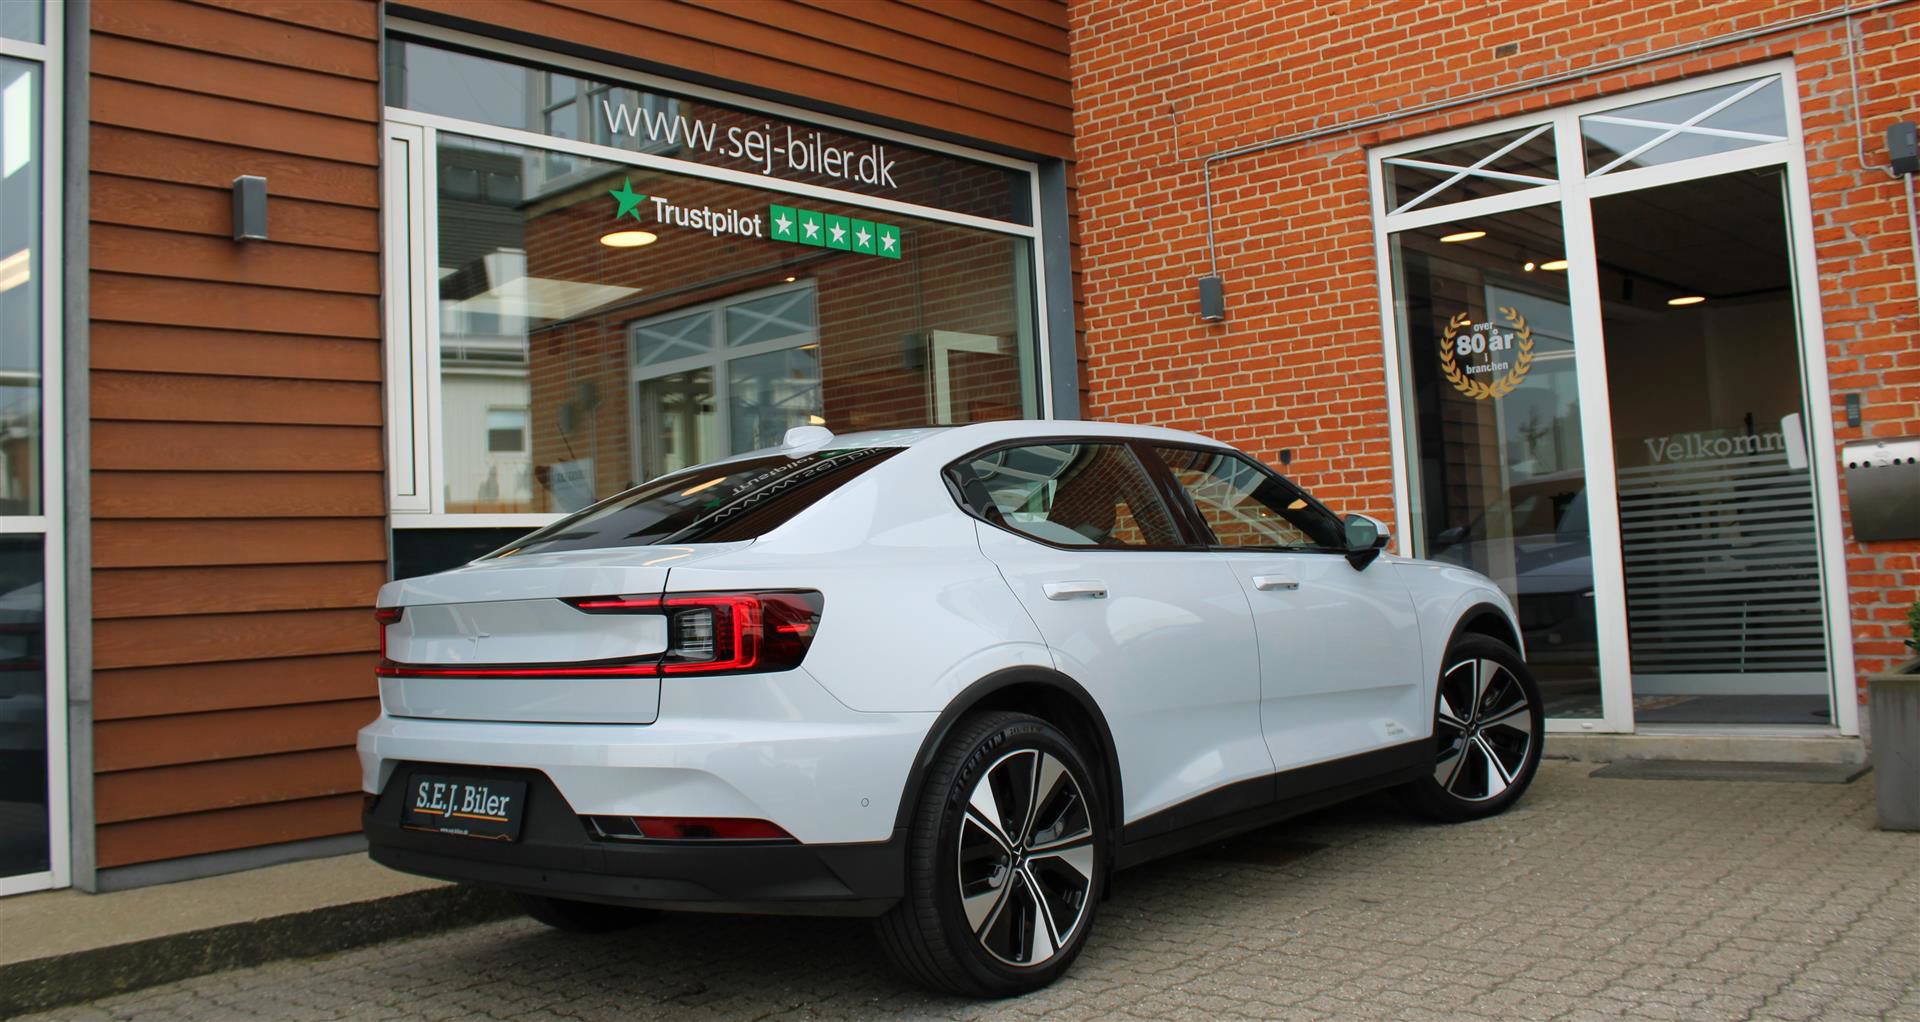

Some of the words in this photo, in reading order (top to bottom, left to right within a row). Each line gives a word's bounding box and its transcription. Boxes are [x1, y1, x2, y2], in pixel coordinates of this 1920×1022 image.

[603, 100, 898, 188] www.sej-biler.dk
[650, 196, 762, 237] Trustpilot
[1456, 333, 1486, 356] 80
[1489, 328, 1514, 352] år
[1473, 322, 1494, 332] over
[1466, 361, 1509, 375] branchen
[1644, 432, 1786, 462] Velkomm
[948, 730, 1005, 808] MICHELIN
[416, 781, 458, 818] S.E.J.
[461, 785, 510, 817] Biler
